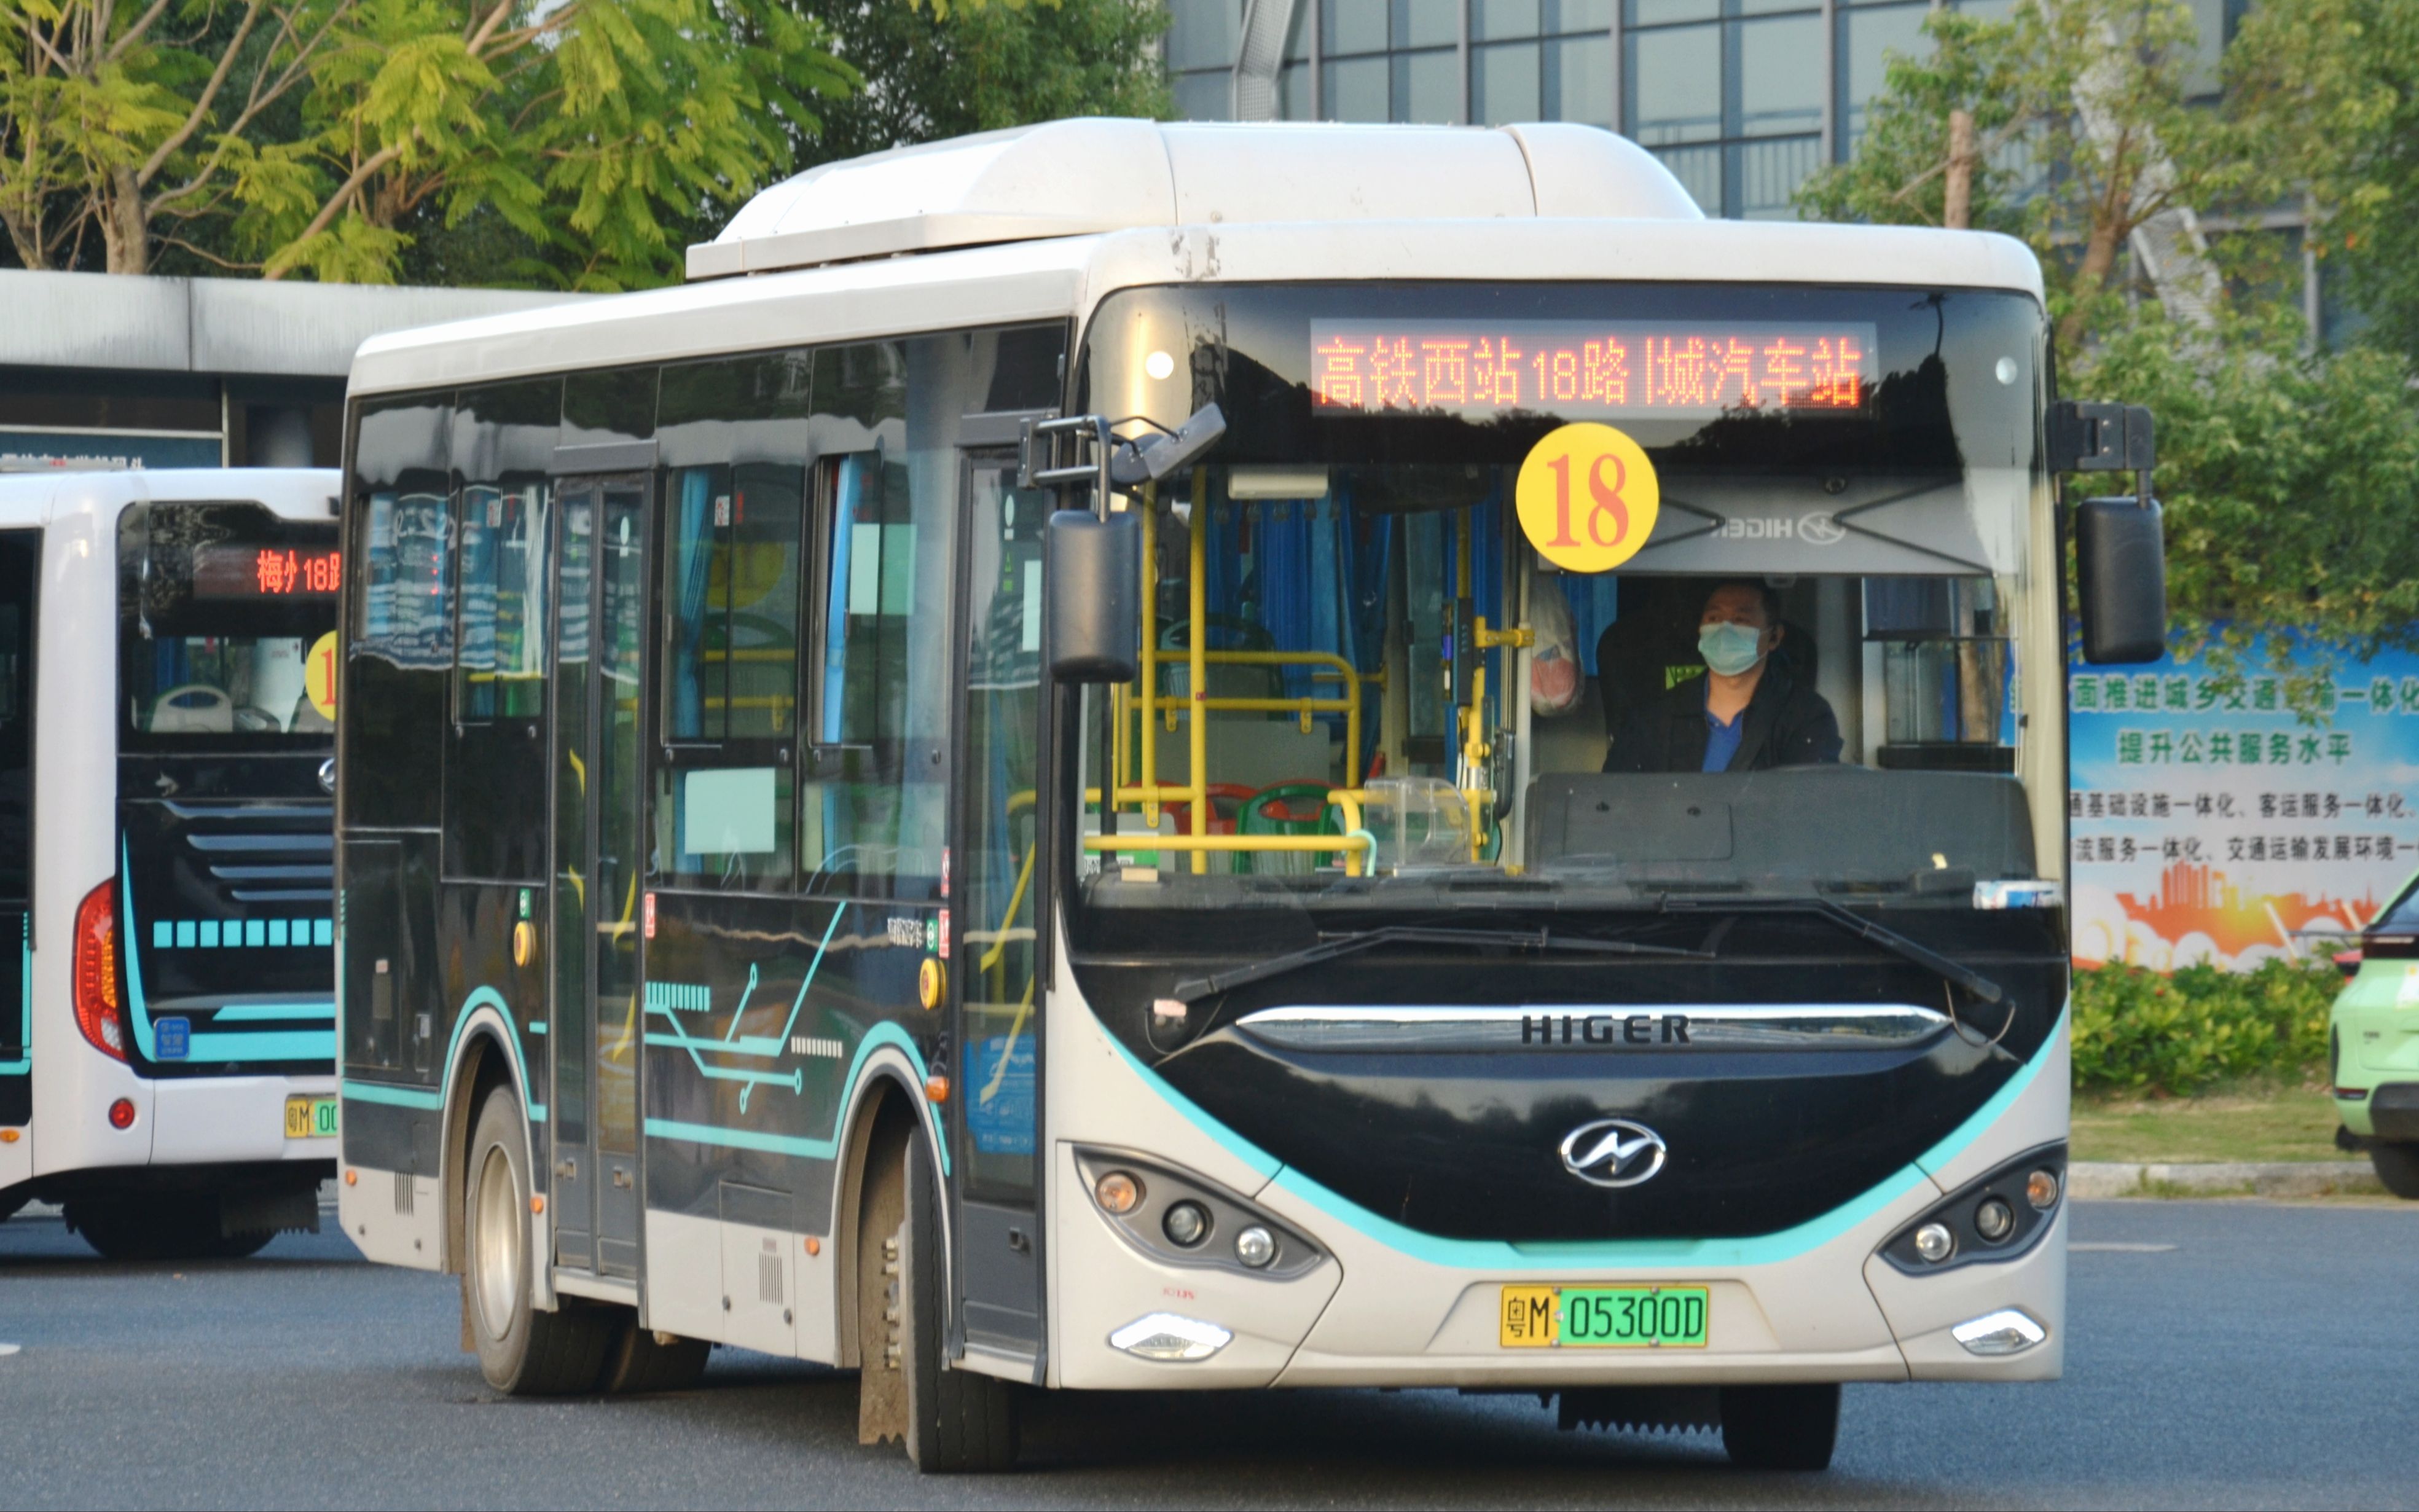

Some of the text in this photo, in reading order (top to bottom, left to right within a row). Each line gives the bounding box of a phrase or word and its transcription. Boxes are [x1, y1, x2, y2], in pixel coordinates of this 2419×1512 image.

[1646, 336, 1861, 406] 城汽车站
[1545, 452, 1629, 548] 18
[2073, 675, 2419, 712] 面推进城乡交通输一体化
[2118, 731, 2351, 766] 提升公共服务水平
[2075, 835, 2419, 861] 流服务一体化、交通运输发展环境一
[1522, 1014, 1690, 1044] HIGER
[1507, 1296, 1703, 1338] 粤M 05300D
